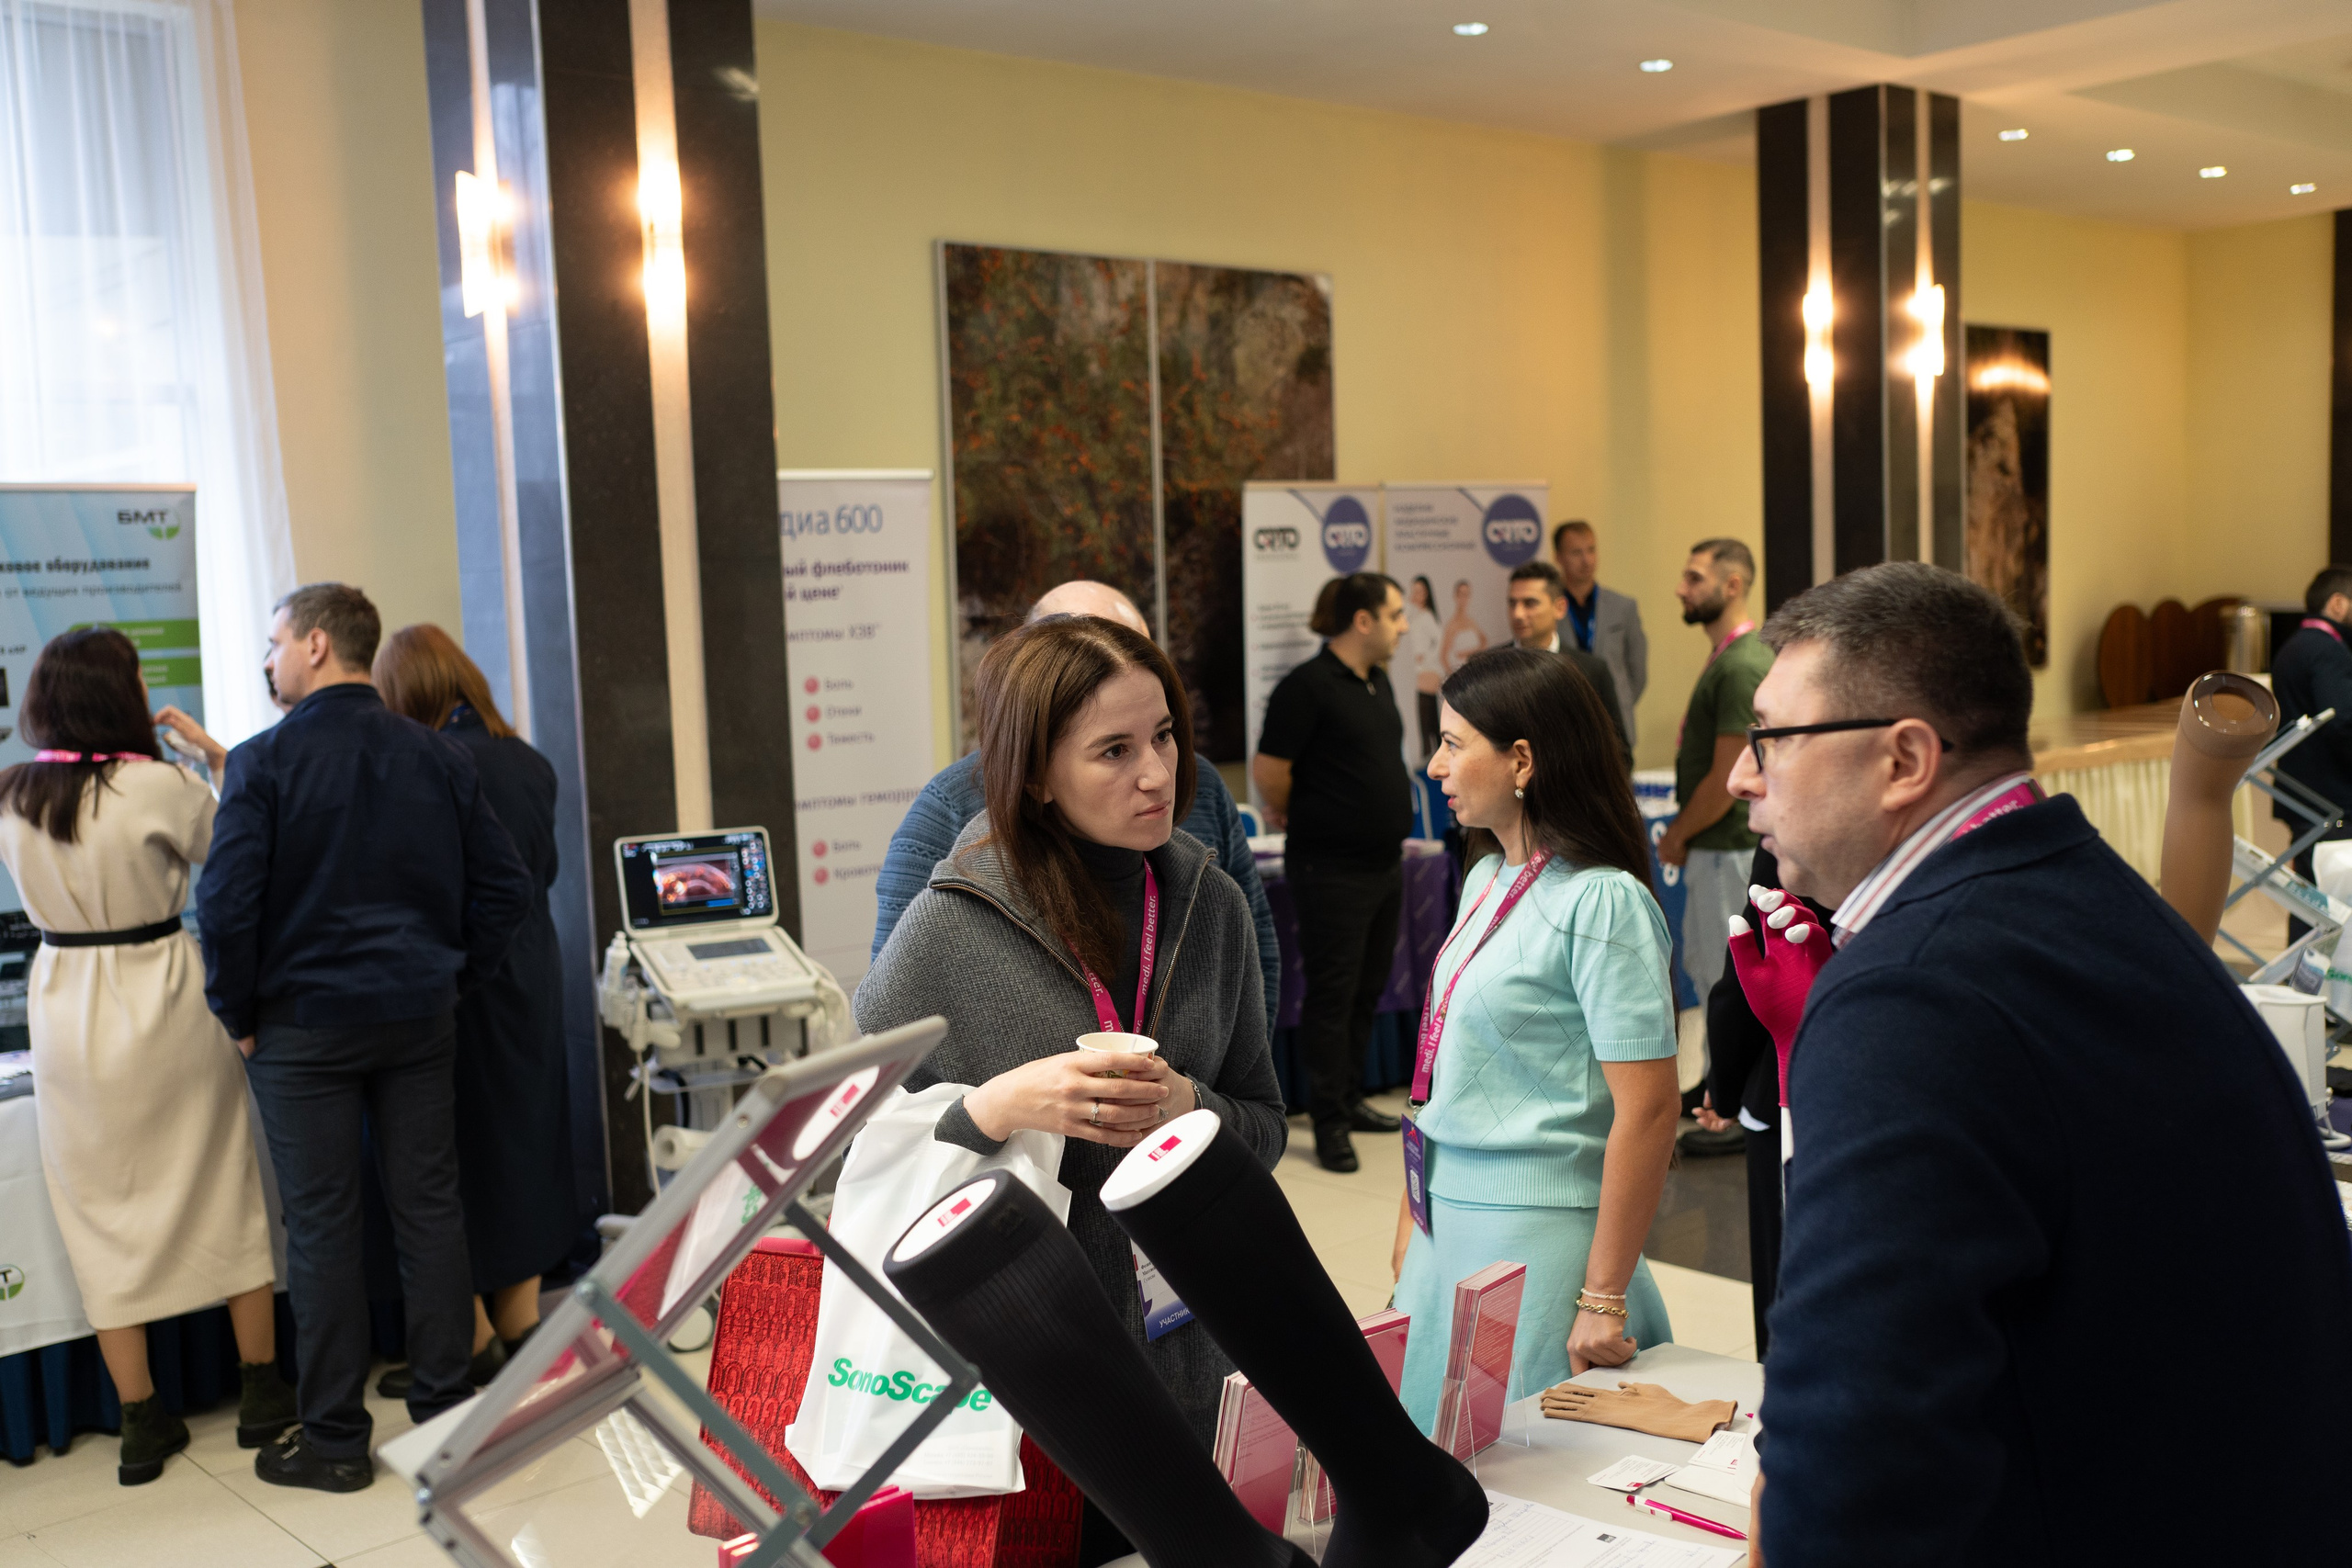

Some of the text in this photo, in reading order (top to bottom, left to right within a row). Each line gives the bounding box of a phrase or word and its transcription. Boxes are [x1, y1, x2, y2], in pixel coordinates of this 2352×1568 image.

[117, 509, 168, 525] БМТ
[835, 503, 883, 534] 600
[47, 555, 150, 575] оборудование
[1507, 870, 1534, 899] better.
[1146, 895, 1156, 932] better.
[1143, 932, 1153, 955] feel
[1142, 964, 1150, 996] medi.
[1421, 1048, 1435, 1074] medi.
[1429, 1022, 1442, 1042] feel
[1159, 1307, 1191, 1328] УЧАСТНИК
